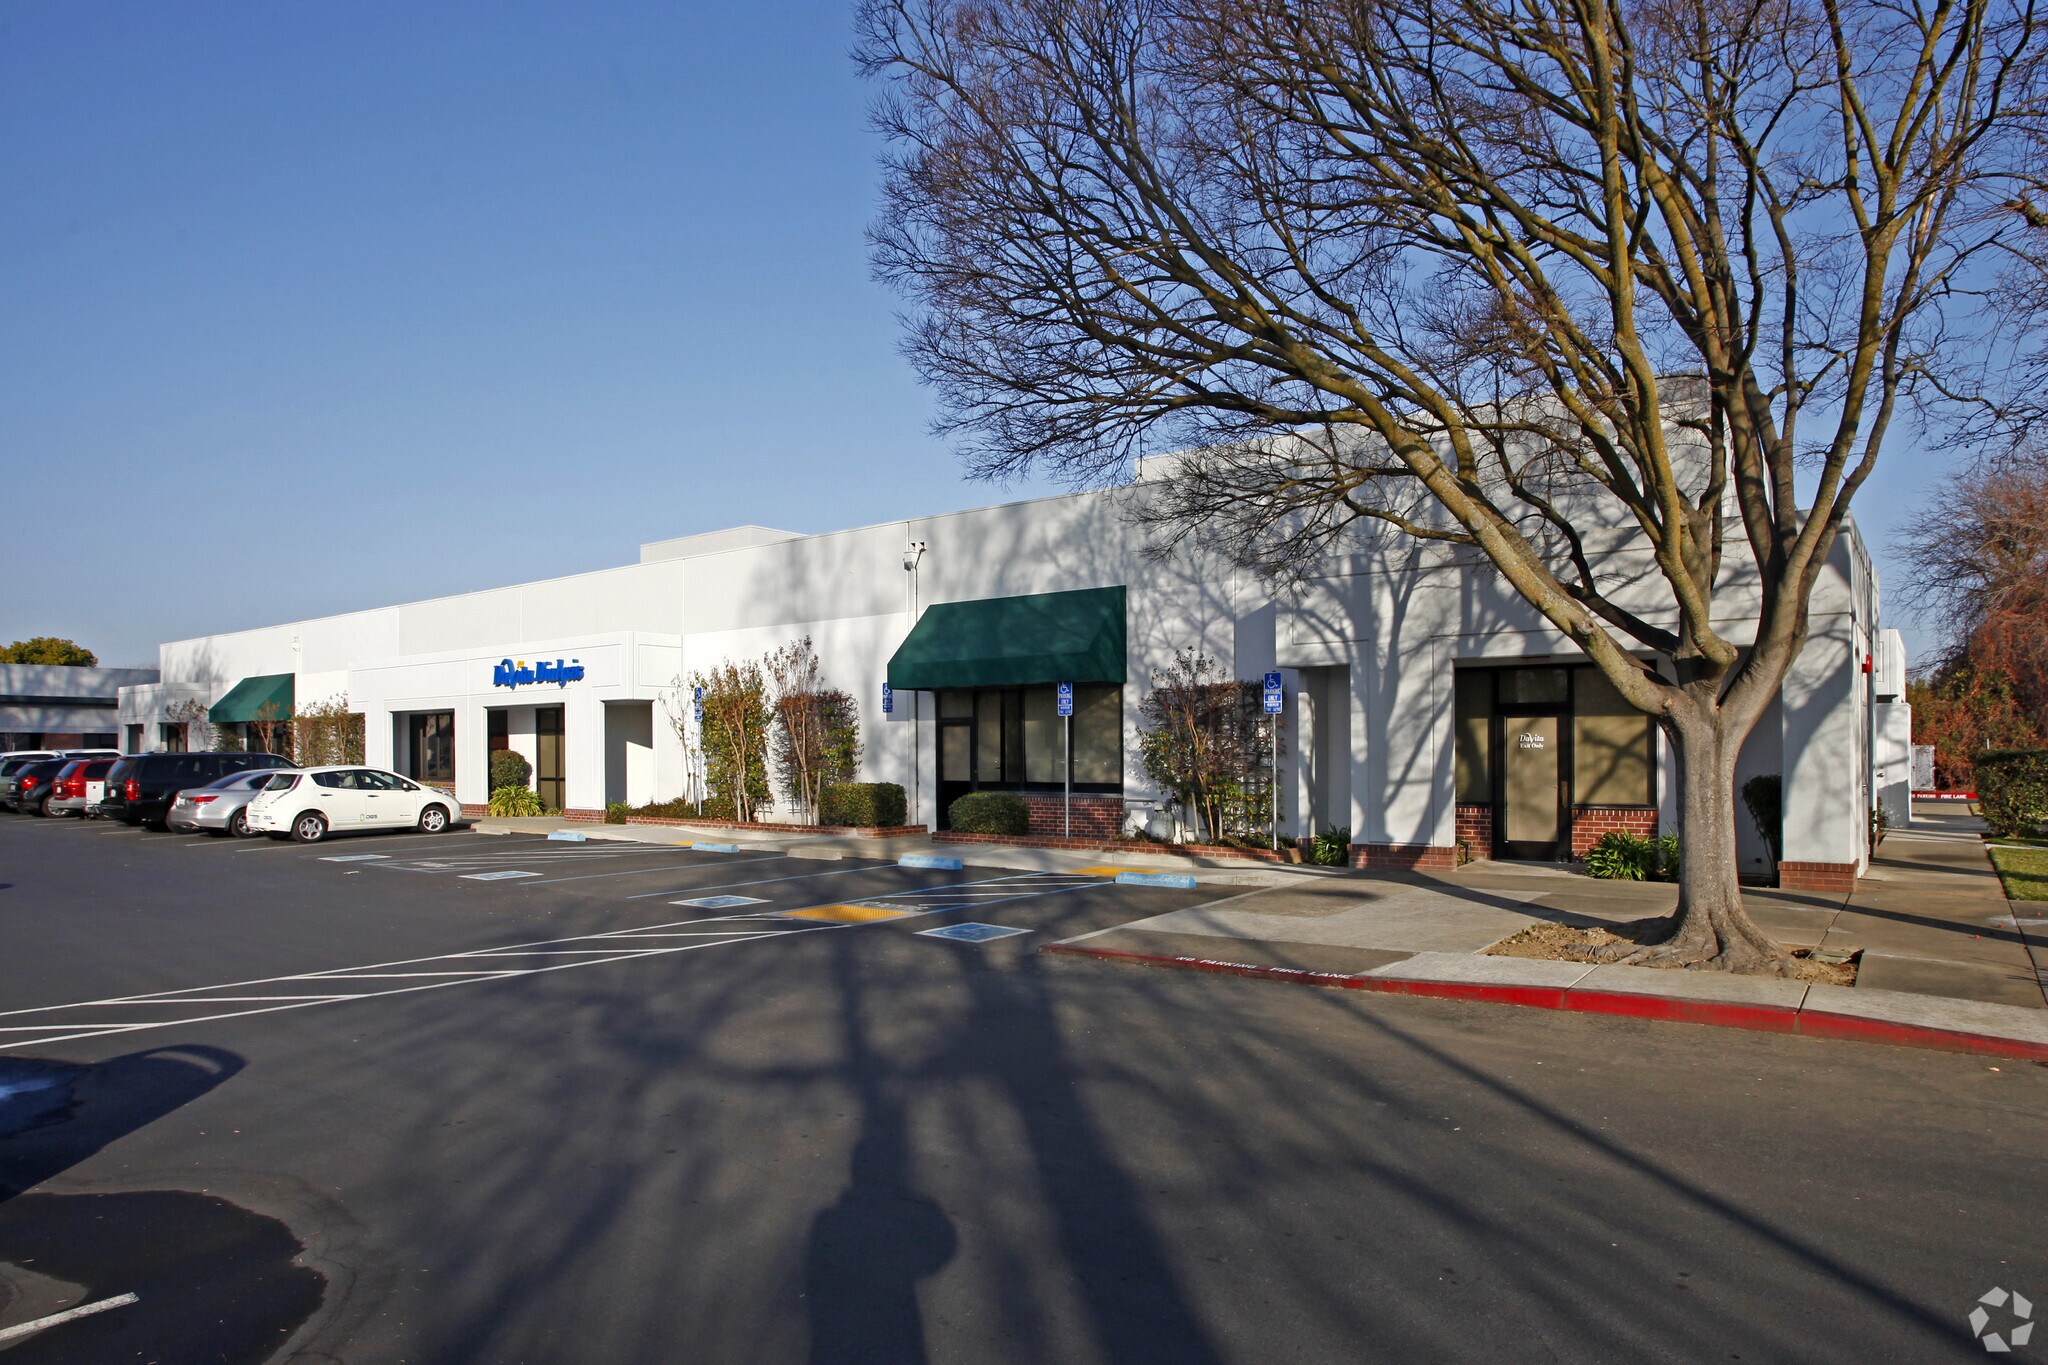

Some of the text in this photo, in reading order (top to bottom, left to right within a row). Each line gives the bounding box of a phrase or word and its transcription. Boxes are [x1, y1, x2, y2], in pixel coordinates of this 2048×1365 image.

[1519, 732, 1544, 743] DaVita
[1199, 958, 1257, 969] PARKING
[1269, 966, 1306, 974] FIRE
[1308, 971, 1355, 980] LANE
